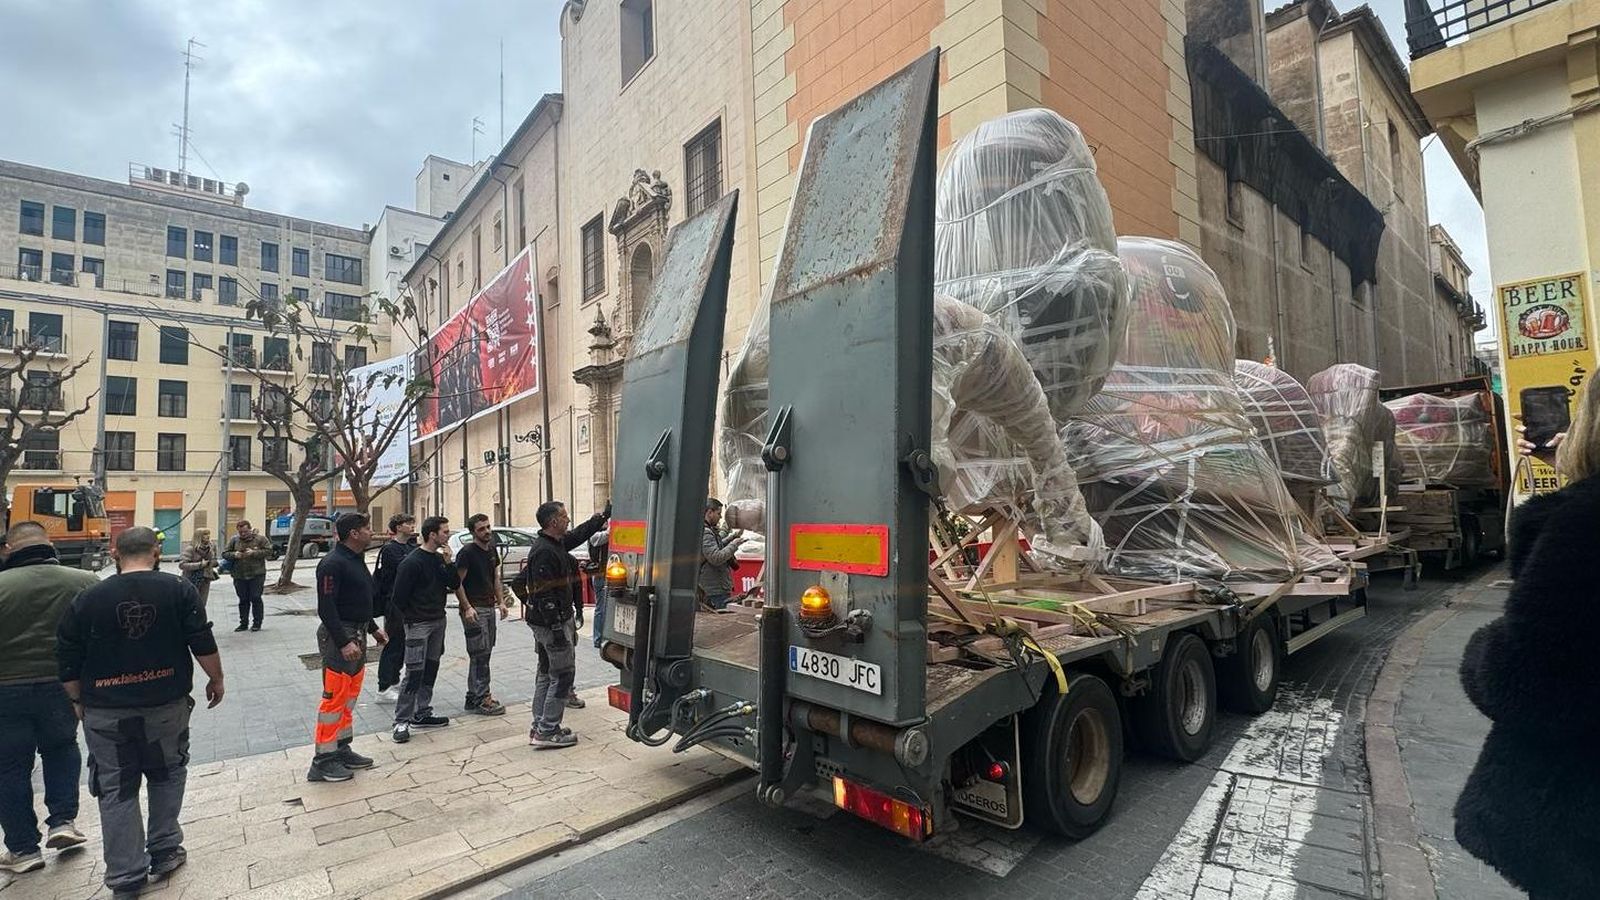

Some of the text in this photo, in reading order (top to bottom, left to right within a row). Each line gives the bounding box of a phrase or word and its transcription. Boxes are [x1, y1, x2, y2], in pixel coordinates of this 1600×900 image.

[1508, 280, 1576, 307] BEER
[1512, 337, 1583, 356] HAPPY HOUR
[801, 652, 876, 689] 4830 JFC
[957, 791, 1006, 814] OCEROS
